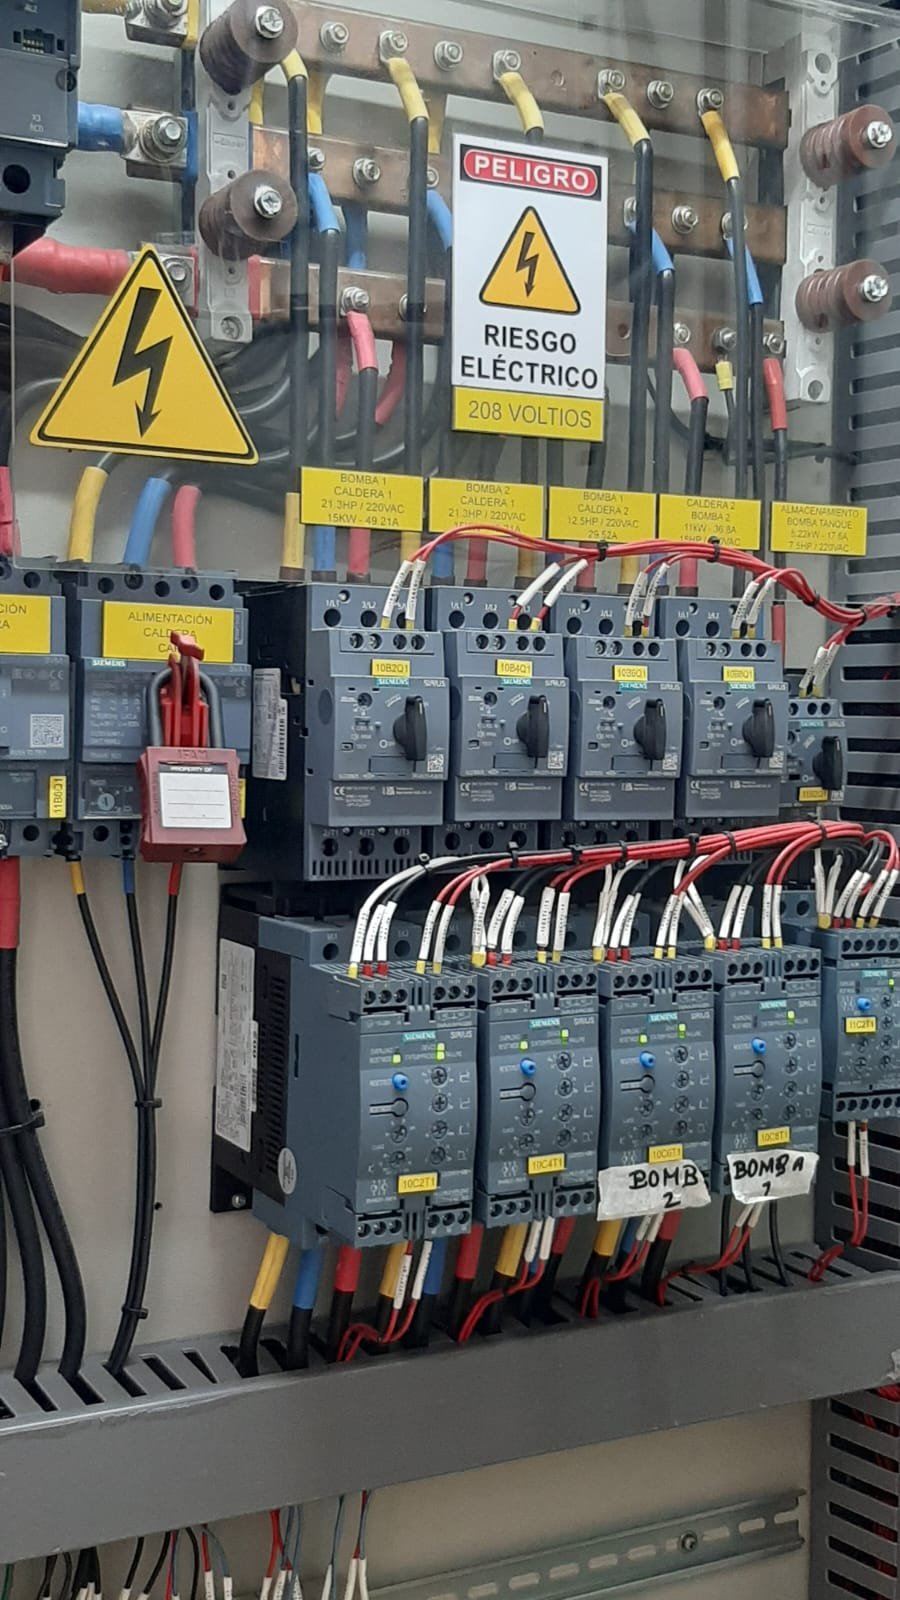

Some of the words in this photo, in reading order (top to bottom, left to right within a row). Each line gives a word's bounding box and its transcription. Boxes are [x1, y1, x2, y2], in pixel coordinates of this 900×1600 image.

[475, 153, 589, 191] PELIGRO
[484, 324, 577, 355] RIESGO
[460, 354, 599, 390] ELÉCTRICO
[468, 401, 503, 423] 208
[508, 403, 593, 429] VOLTIOS
[340, 473, 379, 485] BOMBA
[382, 477, 387, 486] 1
[334, 486, 385, 498] CALDERA
[388, 490, 392, 498] 1
[466, 483, 502, 494] BOMBA
[504, 486, 510, 495] 2
[460, 496, 507, 508] CALDERA
[510, 499, 515, 507] 1
[583, 491, 616, 502] BOMBA
[321, 499, 357, 510] 21.3HP
[366, 502, 405, 513] 220VAC
[577, 503, 621, 515] CALDERA
[624, 507, 629, 516] 2
[686, 498, 729, 510] CALDERA
[730, 501, 736, 510] 2
[490, 511, 526, 522] 220VAC
[691, 511, 724, 521] BOMBA
[725, 513, 731, 522] 2
[781, 505, 859, 518] ALMACENAMIENTO
[366, 515, 400, 527] 49.21A
[606, 518, 640, 529] 220VAC
[787, 517, 818, 527] BOMBA
[819, 519, 853, 530] TANQUE
[128, 611, 213, 625] ALIMENTACIÓN
[375, 663, 409, 673] 10B2Q1
[500, 663, 531, 673] 10B4Q1
[530, 1018, 561, 1028] SIEMENS
[849, 1019, 874, 1029] 11C2T1
[403, 1031, 436, 1041] SIEMENS
[533, 1158, 562, 1170] 10C4T1
[403, 1177, 435, 1189] 10C2T1
[662, 1191, 681, 1209] 2
